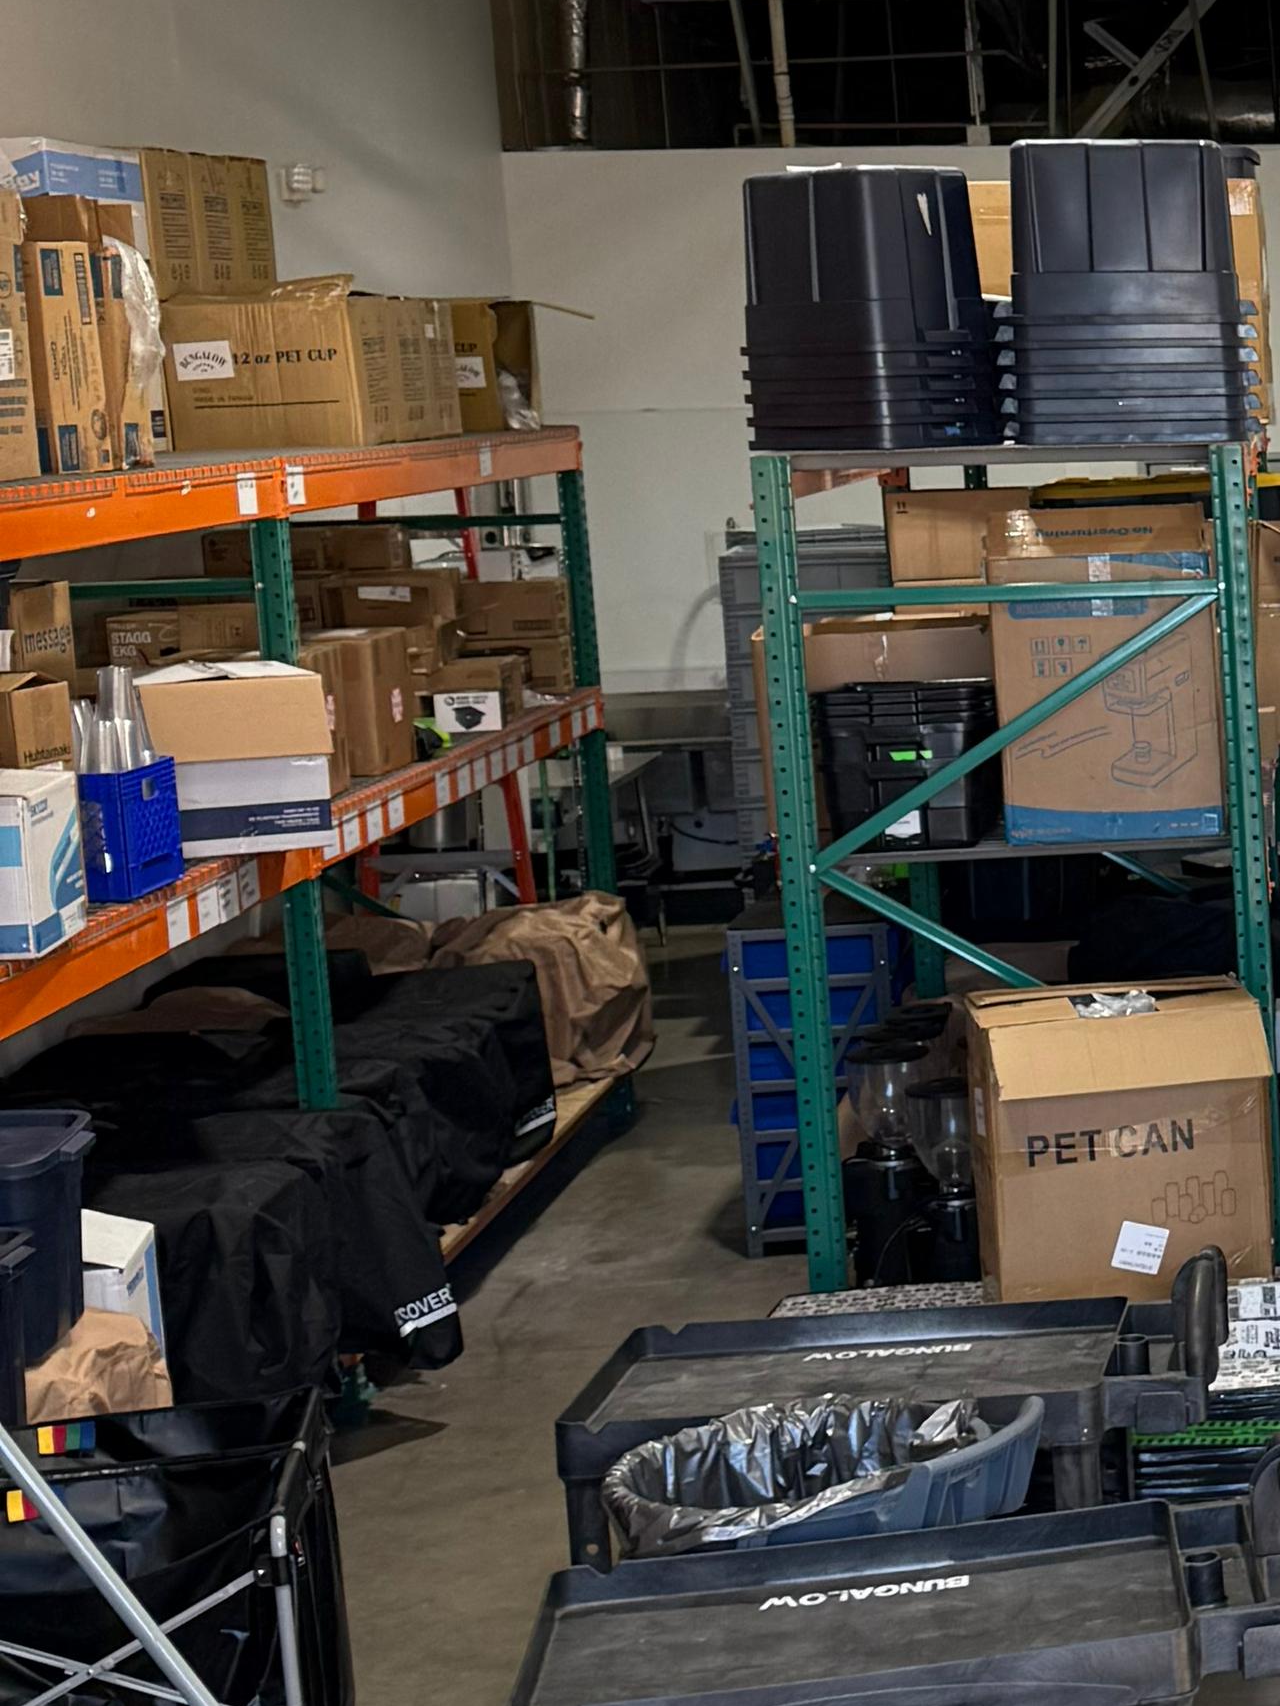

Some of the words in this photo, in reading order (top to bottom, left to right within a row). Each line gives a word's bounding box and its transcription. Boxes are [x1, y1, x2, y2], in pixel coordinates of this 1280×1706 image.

[232, 352, 251, 365] 12
[255, 354, 271, 365] oz
[276, 349, 302, 364] PET
[308, 348, 337, 362] CUP
[1027, 1129, 1102, 1168] PET
[1114, 1118, 1194, 1159] CAN
[802, 1343, 972, 1363] BUNGALOW
[759, 1574, 970, 1611] BUNGALOW
